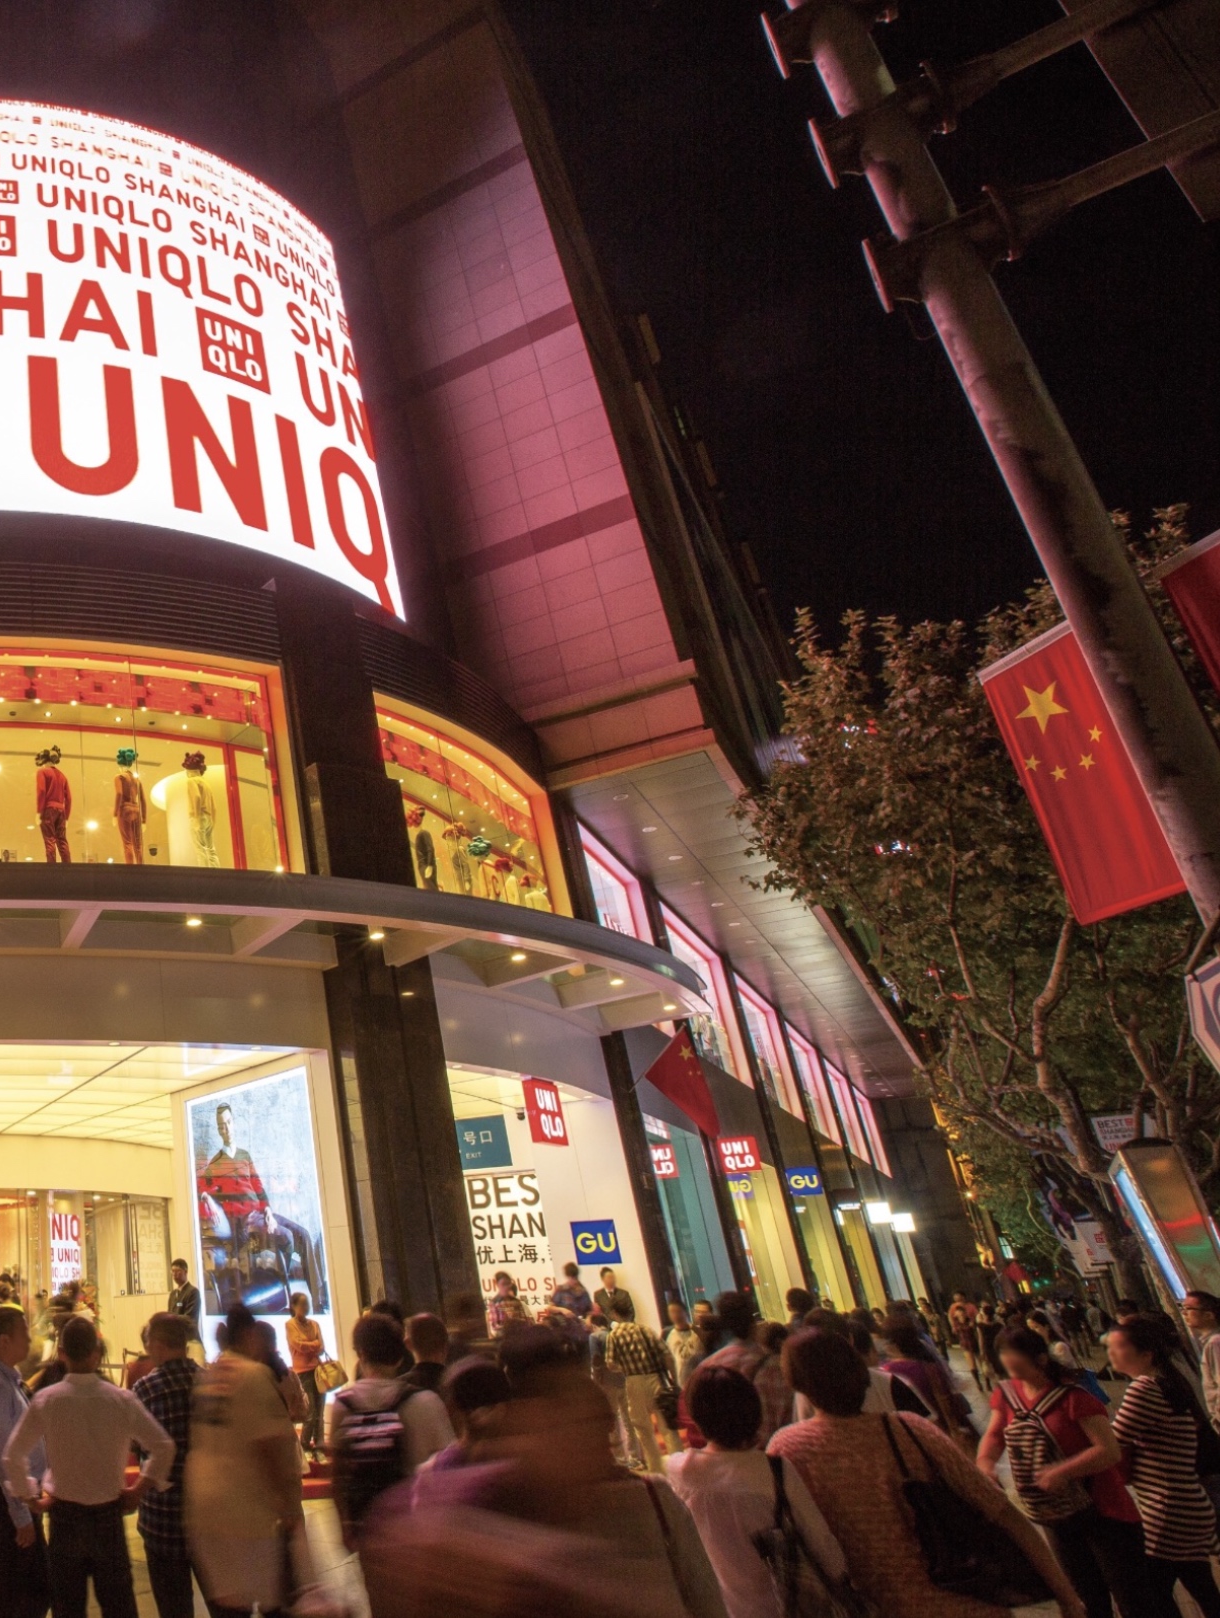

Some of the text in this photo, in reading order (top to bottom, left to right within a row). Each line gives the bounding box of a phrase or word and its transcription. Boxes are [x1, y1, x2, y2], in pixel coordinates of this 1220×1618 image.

[12, 153, 110, 183] UNIQLO
[124, 173, 245, 233] SHANGHAI
[37, 183, 172, 233] UNIQLO
[190, 221, 331, 320] SHANGHAI
[47, 219, 263, 317] UNIQLO
[277, 239, 335, 297] UNIQLO
[204, 318, 255, 355] UNI
[207, 343, 263, 382] QLO
[295, 351, 376, 462] UN
[27, 355, 396, 616] UNIQ
[535, 1088, 558, 1113] UNI
[540, 1114, 564, 1139] QLO
[465, 1151, 482, 1160] EXIT
[721, 1140, 750, 1156] UNI
[724, 1154, 756, 1171] QLO
[467, 1173, 541, 1210] BES
[790, 1174, 819, 1189] GU
[472, 1211, 547, 1241] SHAN
[576, 1231, 616, 1254] GU
[58, 1248, 79, 1265] UNIQ
